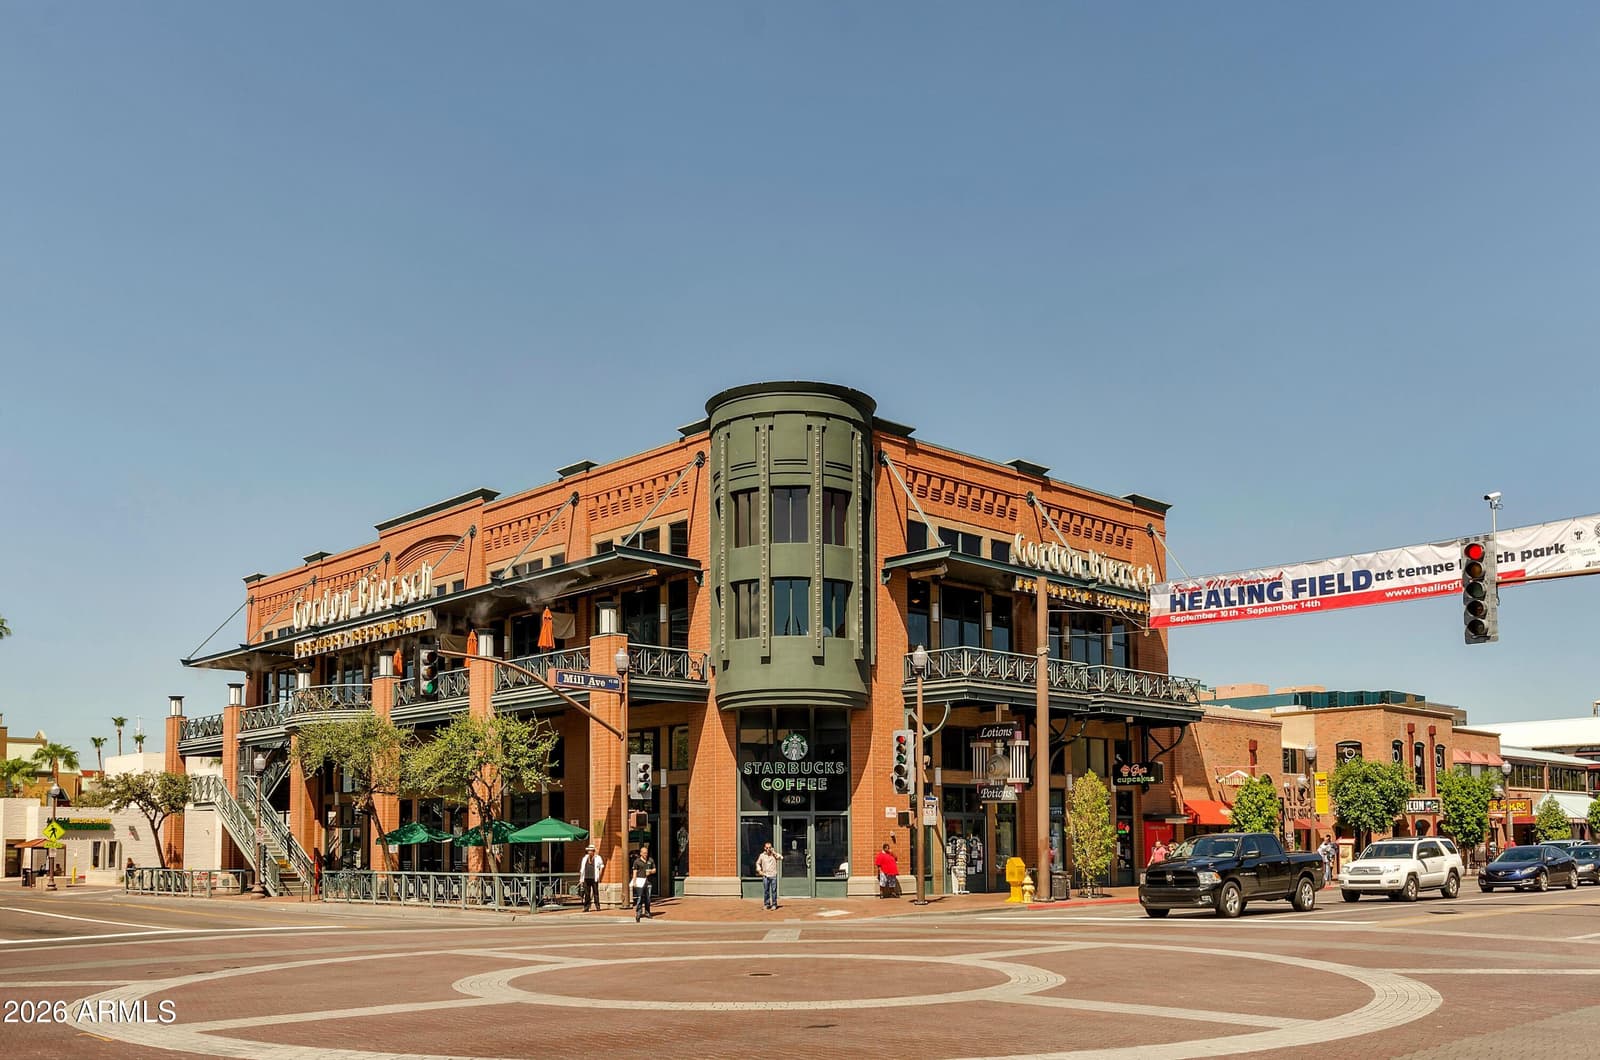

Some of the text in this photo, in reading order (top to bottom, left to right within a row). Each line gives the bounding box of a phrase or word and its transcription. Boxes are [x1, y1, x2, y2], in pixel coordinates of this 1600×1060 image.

[1014, 533, 1155, 592] Gordon Biersch
[1375, 568, 1394, 582] at
[1397, 562, 1455, 579] tempe
[1520, 543, 1565, 562] park
[1228, 571, 1283, 587] Memorial
[293, 560, 432, 632] Gordon Biersch
[1169, 581, 1283, 613] HEALING
[1291, 569, 1373, 599] FIELD
[1385, 580, 1463, 598] www.healingfi
[1169, 611, 1218, 623] September
[1246, 603, 1298, 616] September
[1300, 600, 1321, 610] 14th
[563, 674, 585, 685] Mill
[588, 676, 606, 687] Ave
[980, 726, 1013, 738] Lotions
[743, 761, 845, 775] STARBUCKS
[761, 777, 828, 791] COFFEE
[1117, 775, 1155, 785] cupcakes
[784, 795, 801, 804] 420
[980, 787, 1013, 799] Potions
